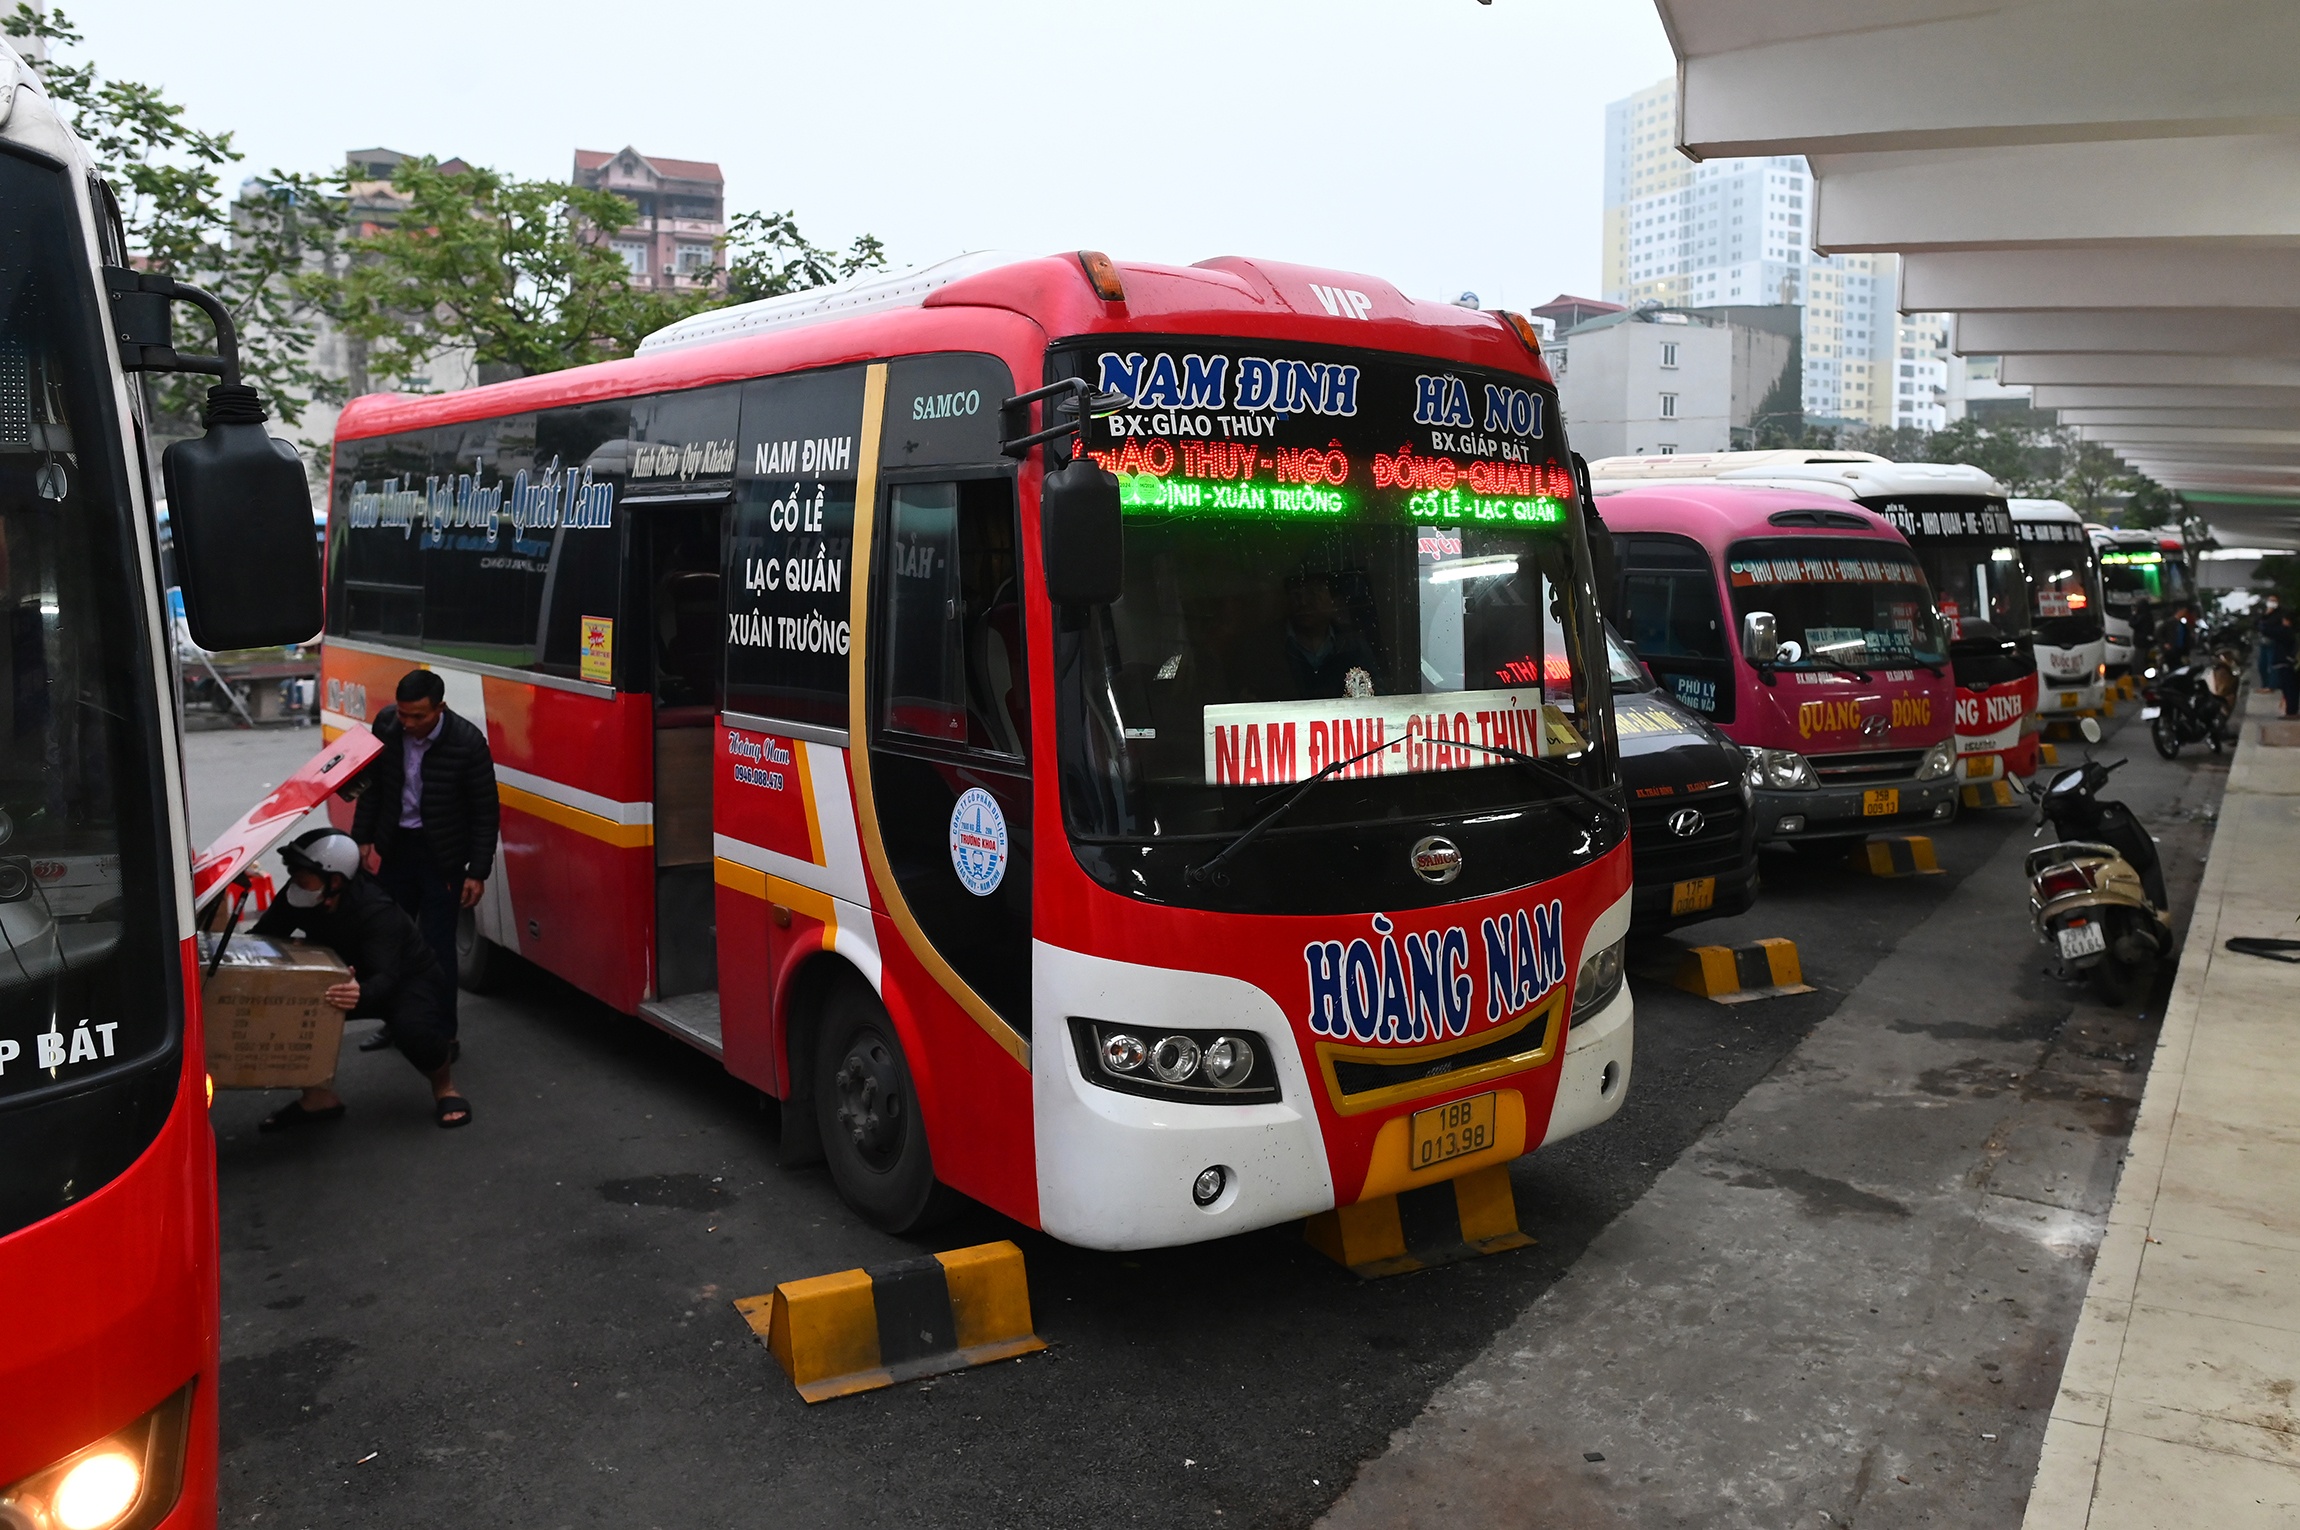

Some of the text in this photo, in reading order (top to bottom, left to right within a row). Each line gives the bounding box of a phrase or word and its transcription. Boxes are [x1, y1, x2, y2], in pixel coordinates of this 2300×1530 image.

[1308, 283, 1372, 320] VIP
[912, 389, 980, 421] SAMCO
[1098, 352, 1360, 420] NAM ĐỊNH
[1413, 373, 1473, 428] HÀ
[1217, 410, 1276, 437] THỦY
[632, 447, 655, 478] Kính
[755, 437, 851, 479] NAM ĐỊNH
[1501, 438, 1530, 464] BÁT
[512, 454, 561, 543] Quất
[561, 465, 613, 529] Lâm
[770, 482, 799, 532] CỔ
[746, 559, 780, 596] LẠC
[785, 542, 841, 593] QUẦN
[728, 608, 850, 655] XUÂN TRƯỜNG
[1495, 653, 1572, 684] TP.THÁ BÌN
[1798, 698, 1862, 739] QUANG
[1985, 694, 2022, 725] NINH
[729, 731, 790, 765] Hoàng Nam
[1214, 722, 1297, 787] NAM
[1407, 711, 1471, 775] GIAO
[1476, 695, 1539, 768] THỦY
[982, 838, 997, 851] KHOA
[1417, 852, 1459, 868] SAMCO
[1304, 899, 1566, 1044] HOÀNG NAM
[37, 1018, 119, 1069] BÁT
[1440, 1102, 1472, 1131] 18B
[1421, 1124, 1485, 1163] 013.98
